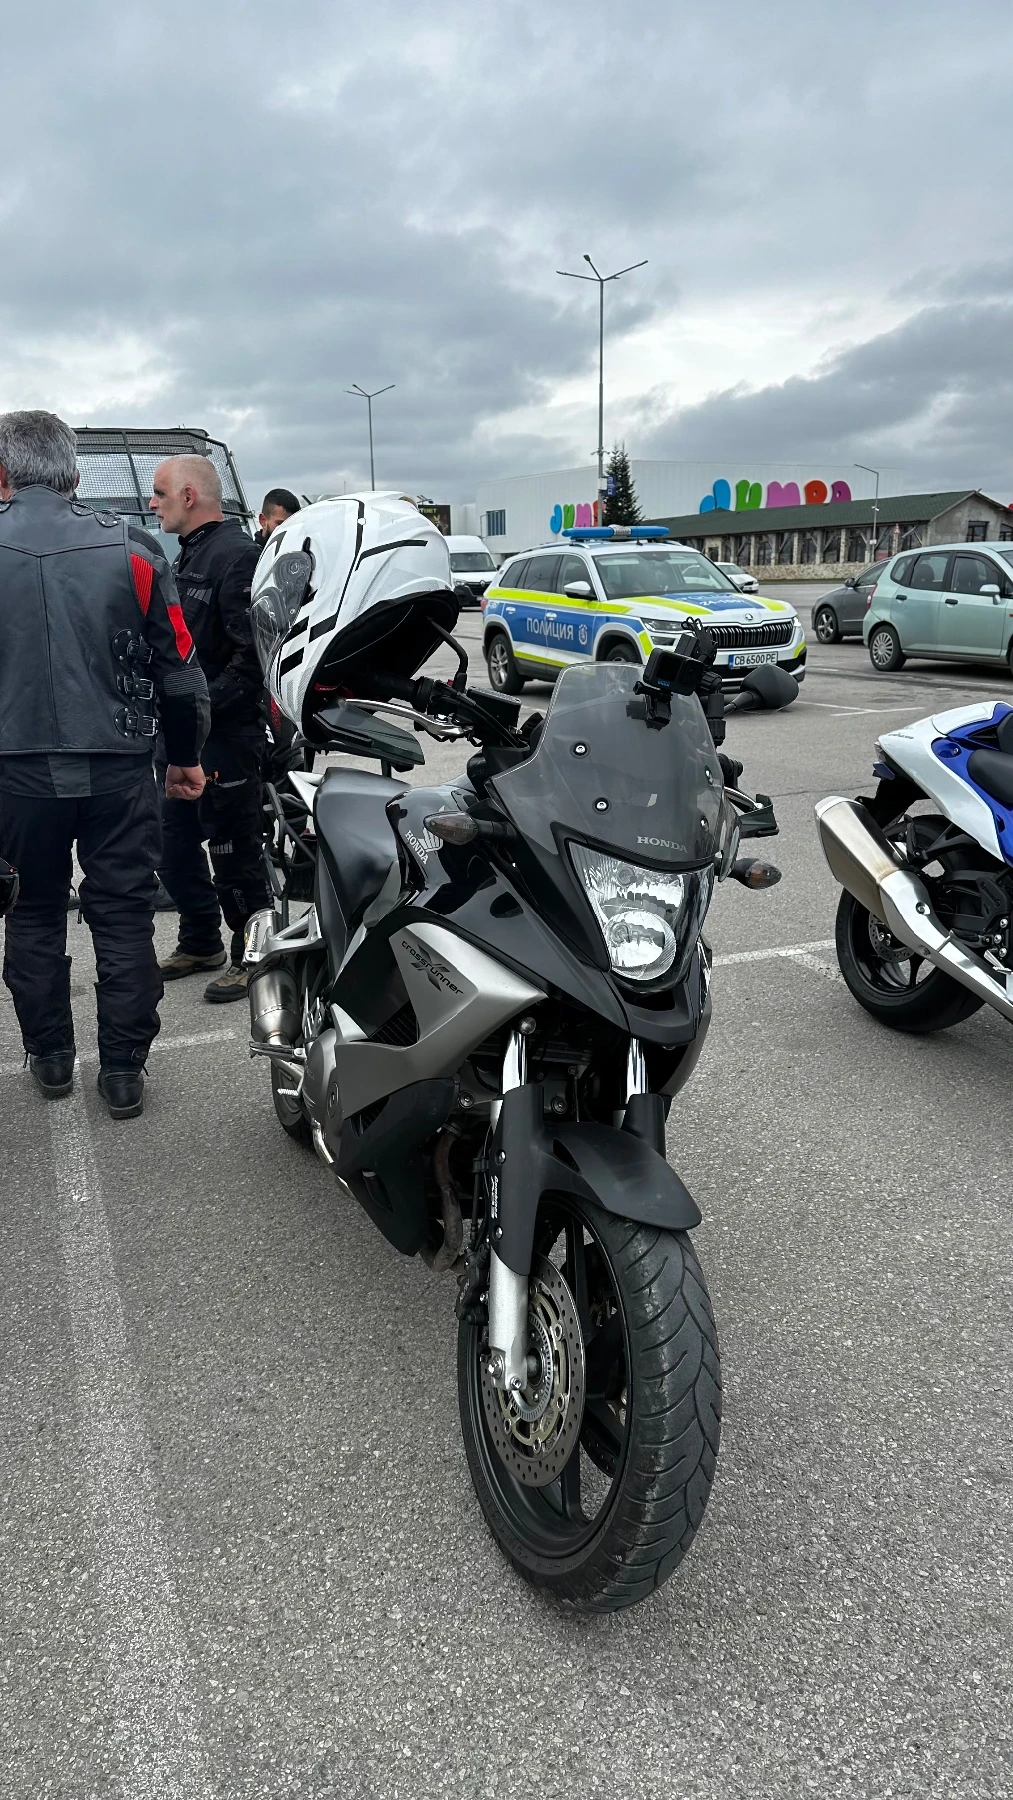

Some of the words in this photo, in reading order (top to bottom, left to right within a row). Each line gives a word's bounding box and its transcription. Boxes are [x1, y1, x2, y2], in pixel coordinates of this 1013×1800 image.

[526, 617, 574, 641] ПОЛИЦИЯ
[746, 654, 765, 665] 6500
[405, 829, 429, 865] HONDA
[636, 835, 689, 854] HONDA
